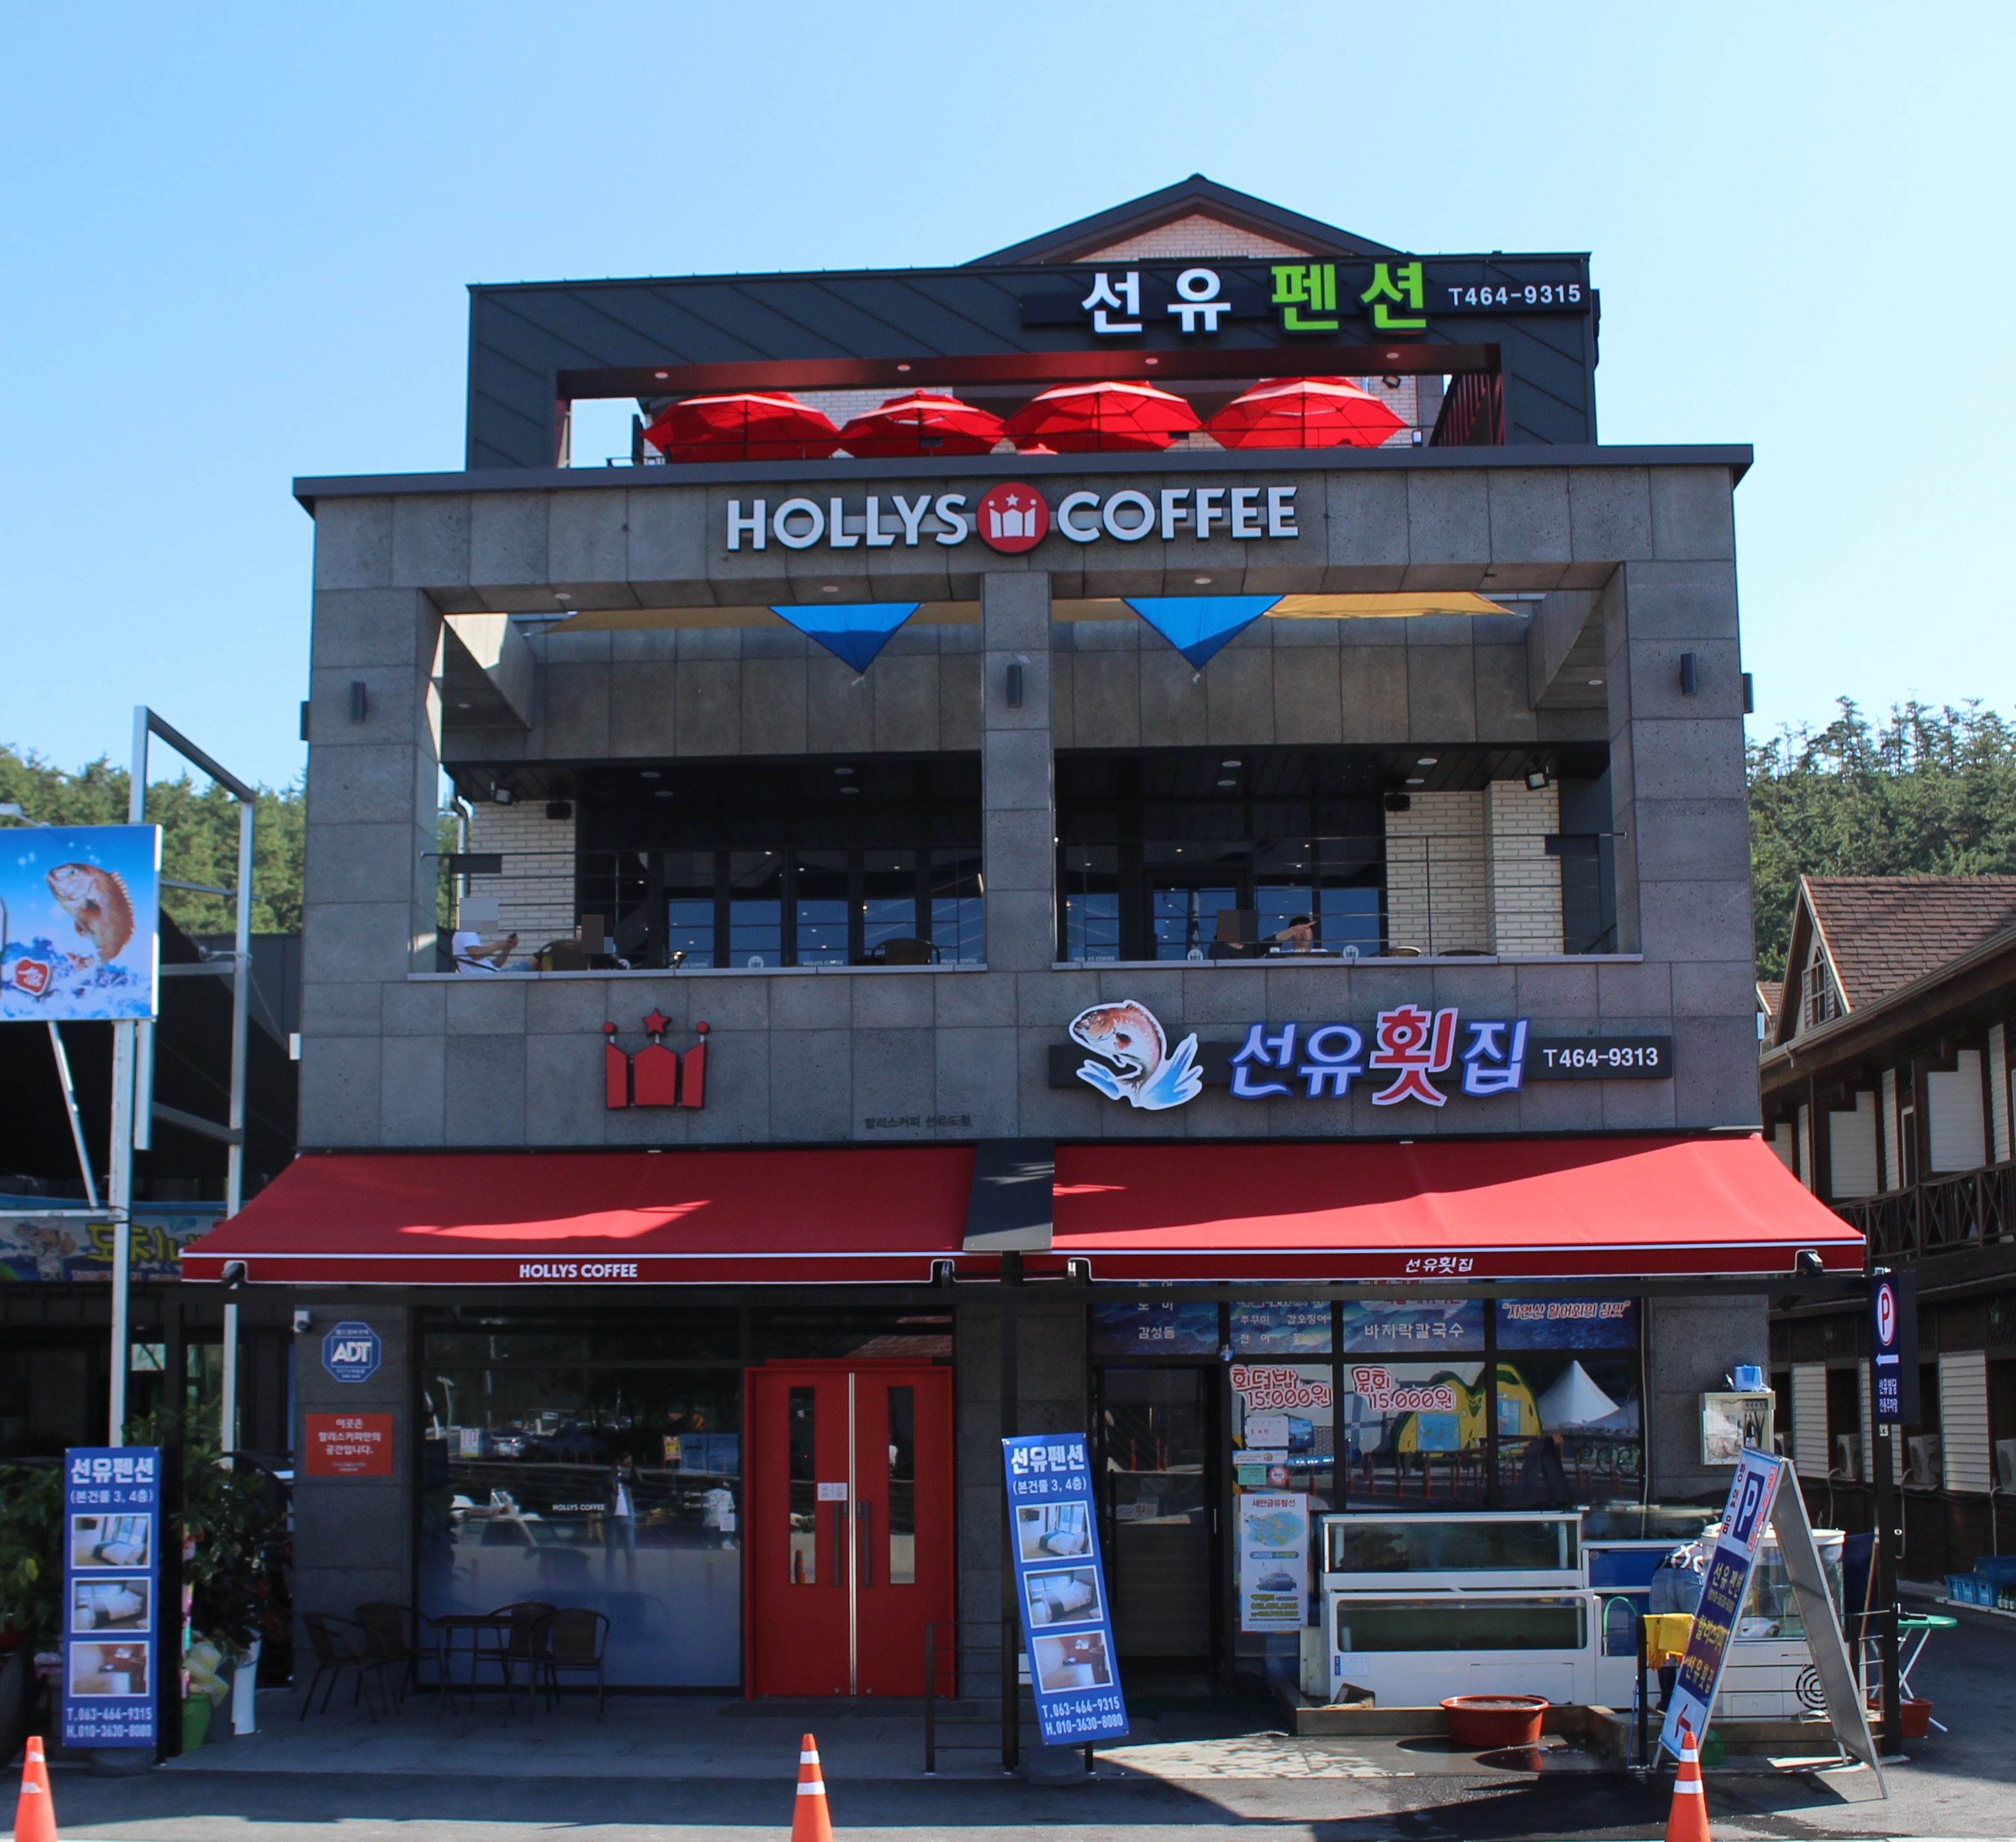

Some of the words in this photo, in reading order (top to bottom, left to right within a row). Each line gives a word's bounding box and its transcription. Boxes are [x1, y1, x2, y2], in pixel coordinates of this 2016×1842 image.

[1448, 284, 1581, 307] T464-9315
[727, 494, 968, 550] HOLLYS
[1058, 486, 1298, 542] COFFEE
[1229, 1004, 1532, 1107] 선유횟집
[1543, 1047, 1659, 1068] T464-9313
[519, 1265, 578, 1278] HOLLYS
[580, 1263, 638, 1277] COFFEE
[1405, 1257, 1474, 1274] 선유횟집
[1882, 1293, 1890, 1335] P
[1139, 1327, 1175, 1339] 감성돔
[1364, 1323, 1464, 1339] 바지락칼국수
[331, 1342, 373, 1362] ADT
[1231, 1367, 1297, 1391] 회덮밥
[1355, 1370, 1390, 1393] 물회
[71, 1457, 154, 1484] 선유펜션
[1011, 1444, 1084, 1475] 선유펜션
[1737, 1479, 1759, 1532] P
